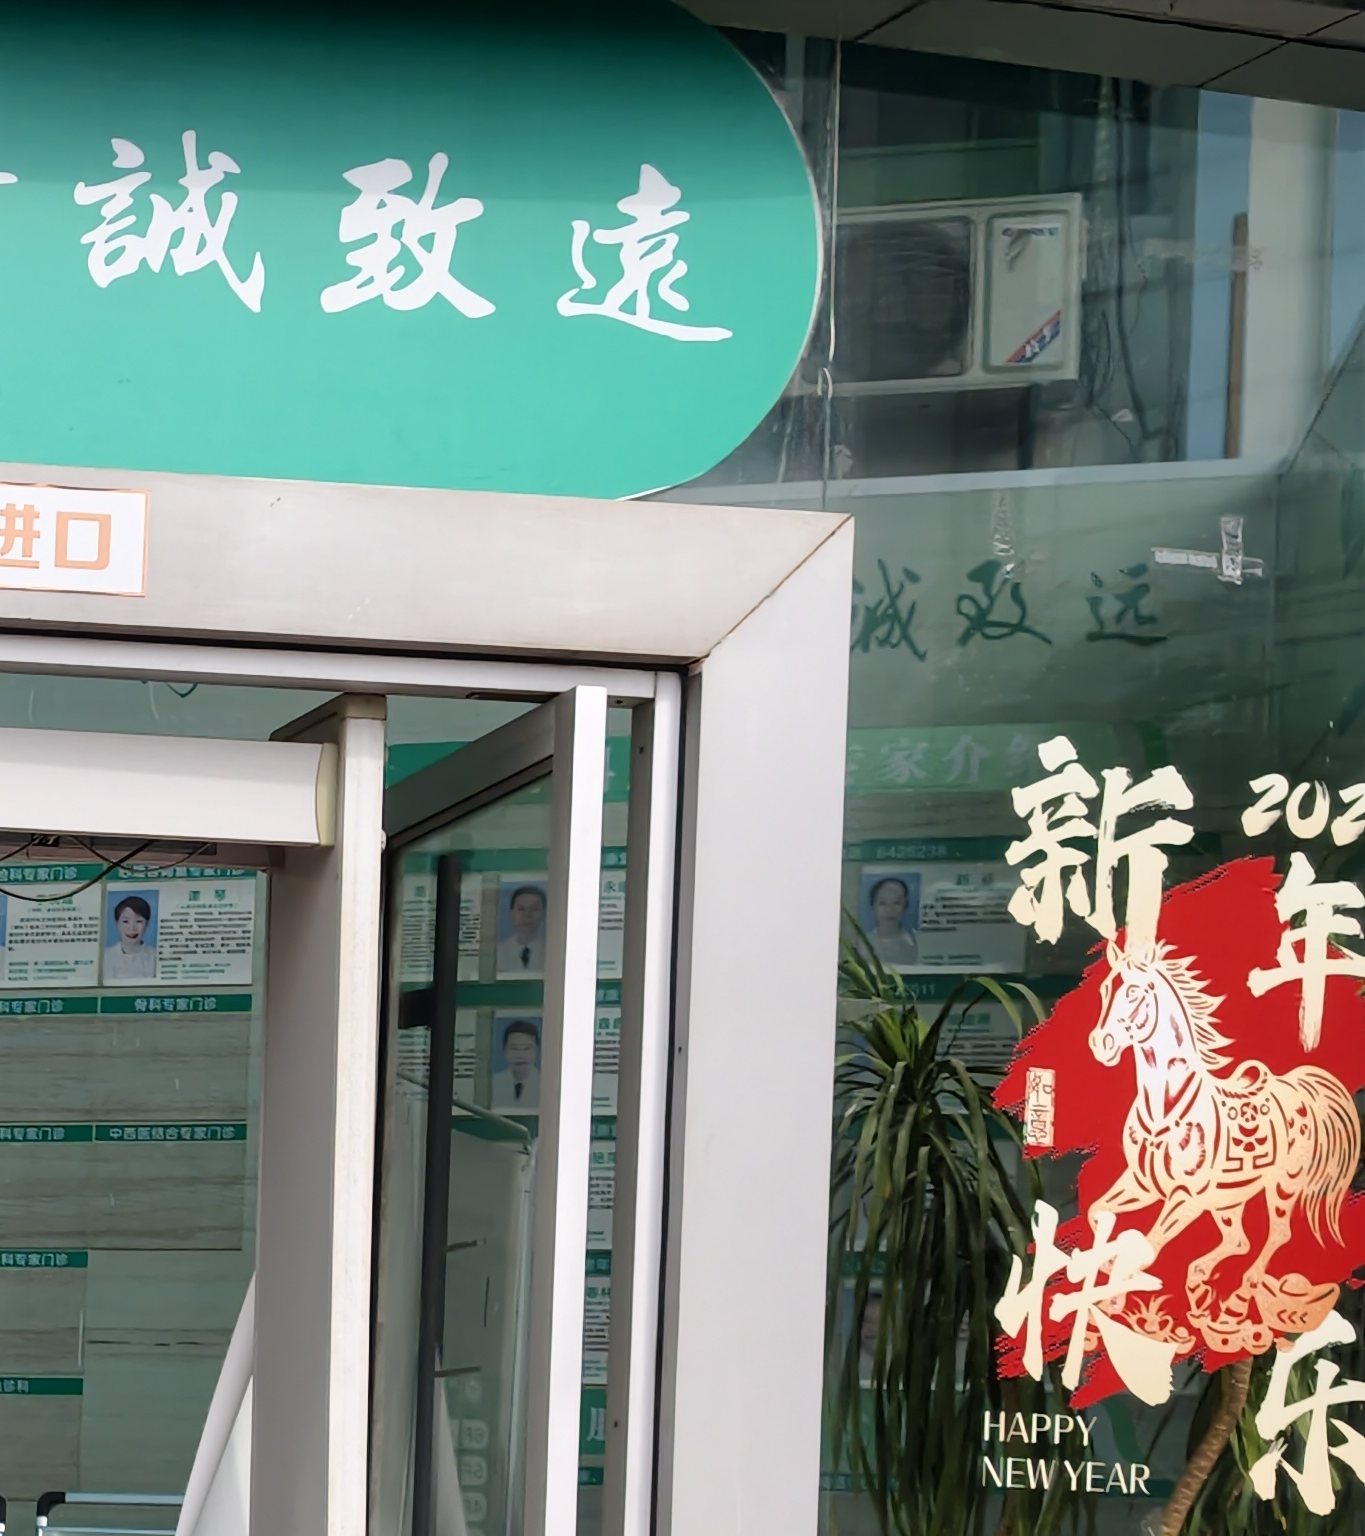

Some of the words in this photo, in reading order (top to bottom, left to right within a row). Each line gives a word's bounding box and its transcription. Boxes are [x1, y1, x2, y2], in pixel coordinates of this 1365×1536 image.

[1005, 735, 1194, 945] 新
[1246, 851, 1365, 1052] 年
[994, 1199, 1174, 1406] 快
[981, 1455, 1054, 1492] NEW
[1065, 1459, 1152, 1496] YEAR
[982, 1410, 1097, 1447] HAPPY
